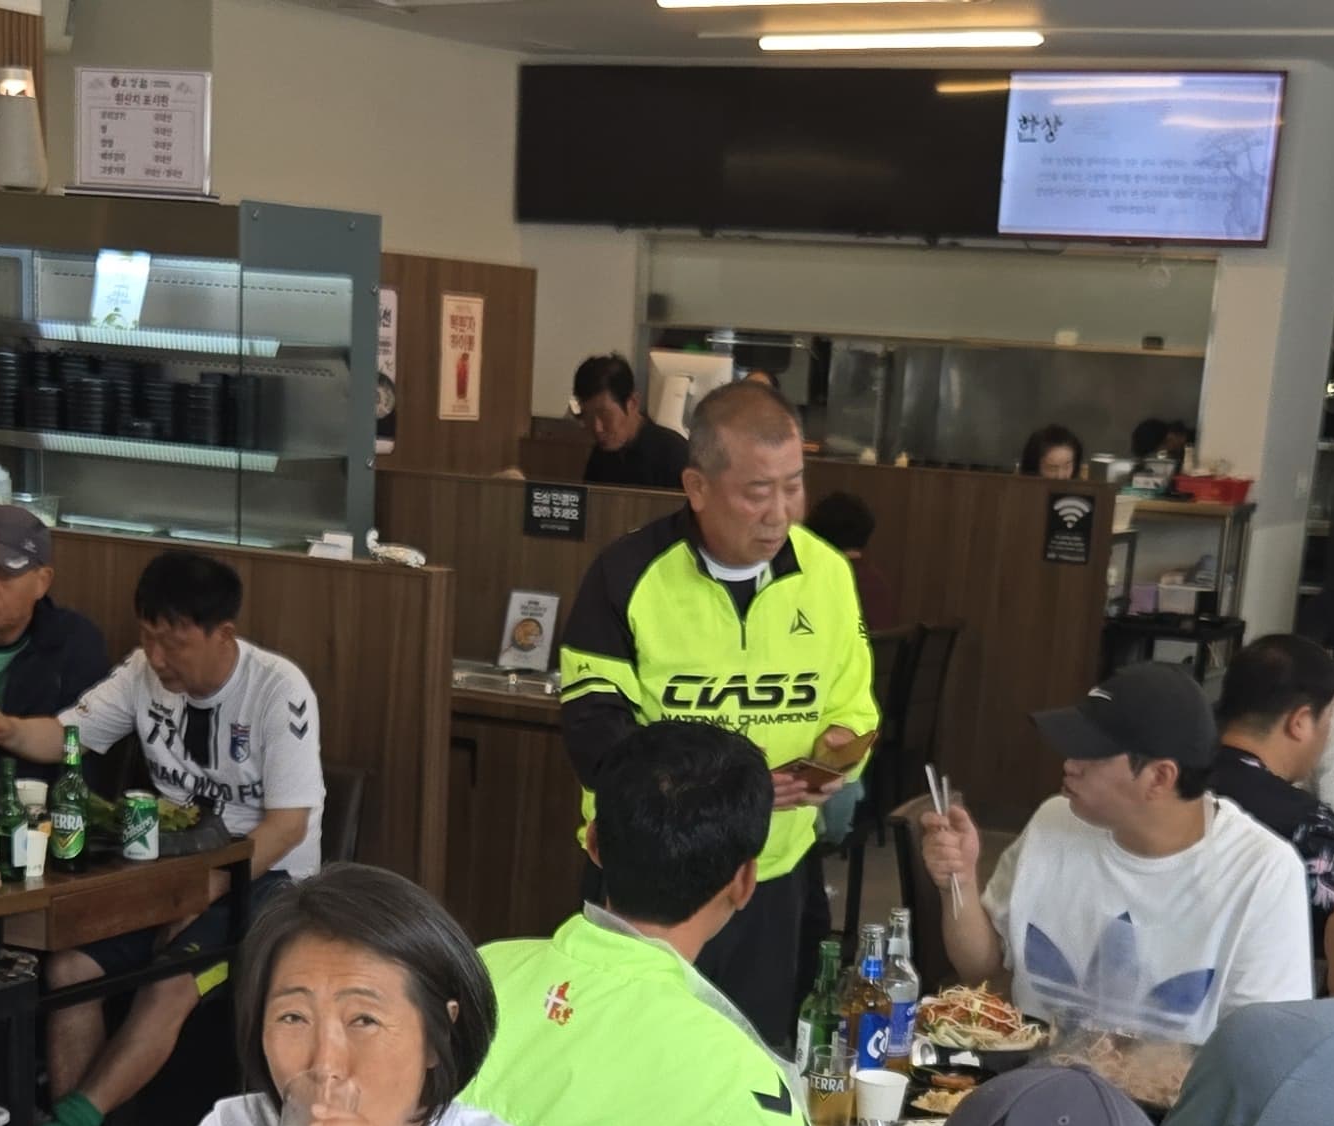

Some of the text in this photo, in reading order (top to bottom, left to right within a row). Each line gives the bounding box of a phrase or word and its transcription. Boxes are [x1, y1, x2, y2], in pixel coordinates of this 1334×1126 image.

[738, 711, 819, 726] CHAMPIONS
[50, 811, 85, 832] TERRA
[810, 1076, 845, 1093] TERRA
